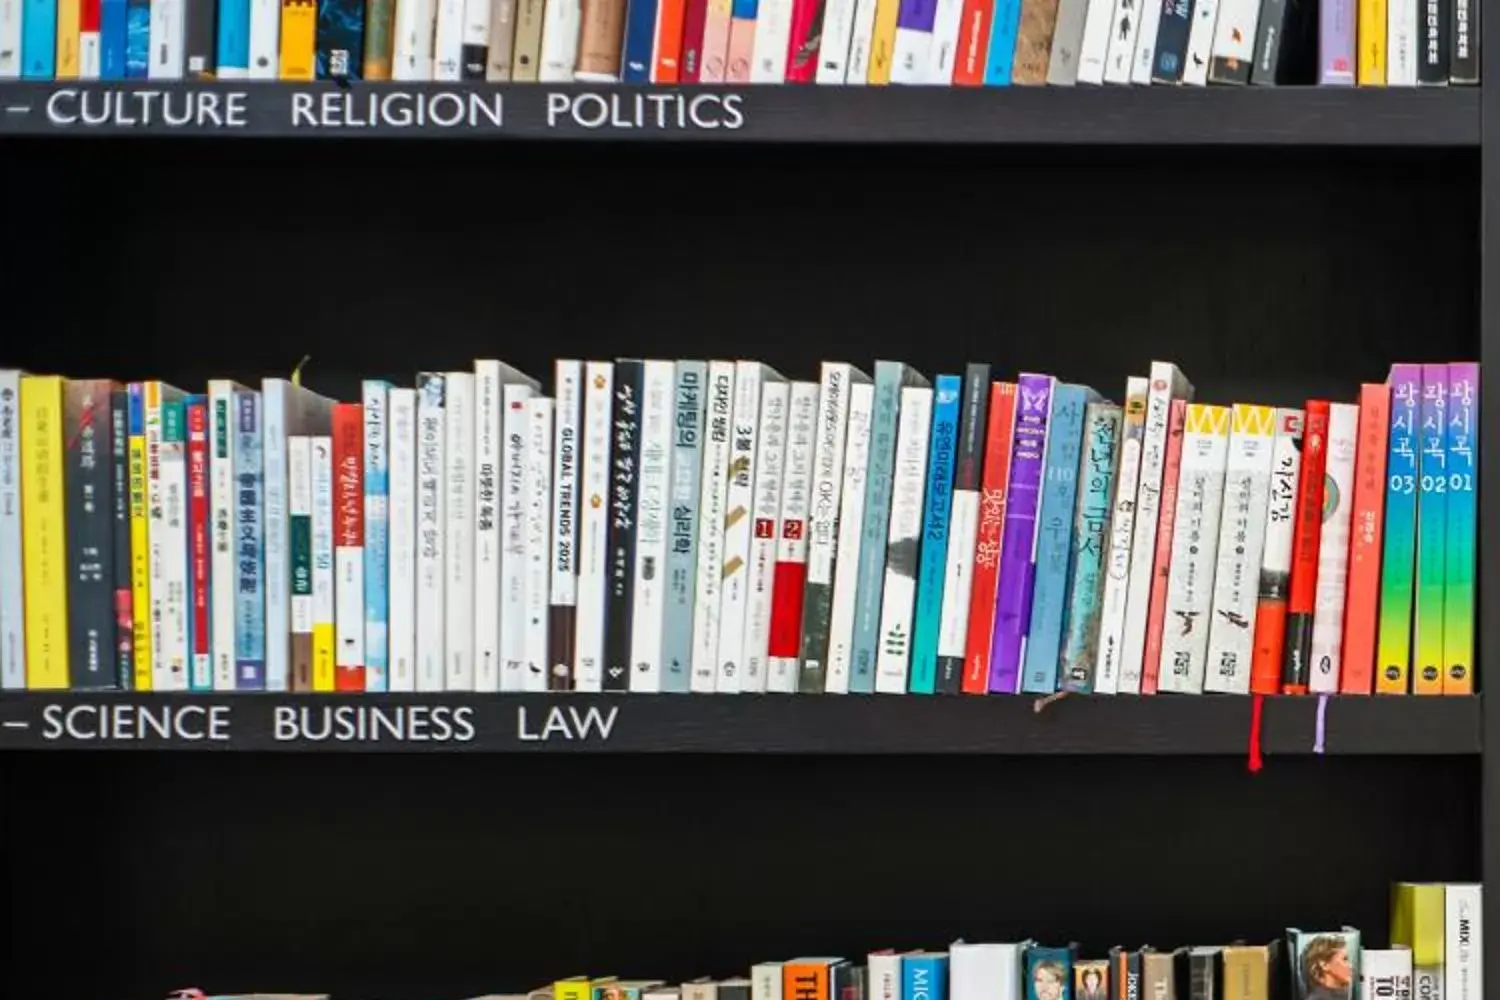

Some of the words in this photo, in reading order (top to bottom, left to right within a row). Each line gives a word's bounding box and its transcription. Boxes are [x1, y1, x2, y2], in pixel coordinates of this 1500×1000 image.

[46, 91, 246, 125] CULTURE
[291, 92, 502, 128] RELIGION
[547, 93, 744, 130] POLITICS
[560, 427, 573, 480] GLOBAL
[1391, 475, 1414, 494] 03
[1422, 475, 1446, 493] 02
[1450, 473, 1472, 491] 01
[559, 483, 571, 536] TRENDS
[558, 541, 570, 572] 2025
[43, 705, 230, 740] SCIENCE
[274, 706, 474, 742] BUSINESS
[518, 707, 618, 740] LAW
[1375, 975, 1395, 997] TO
